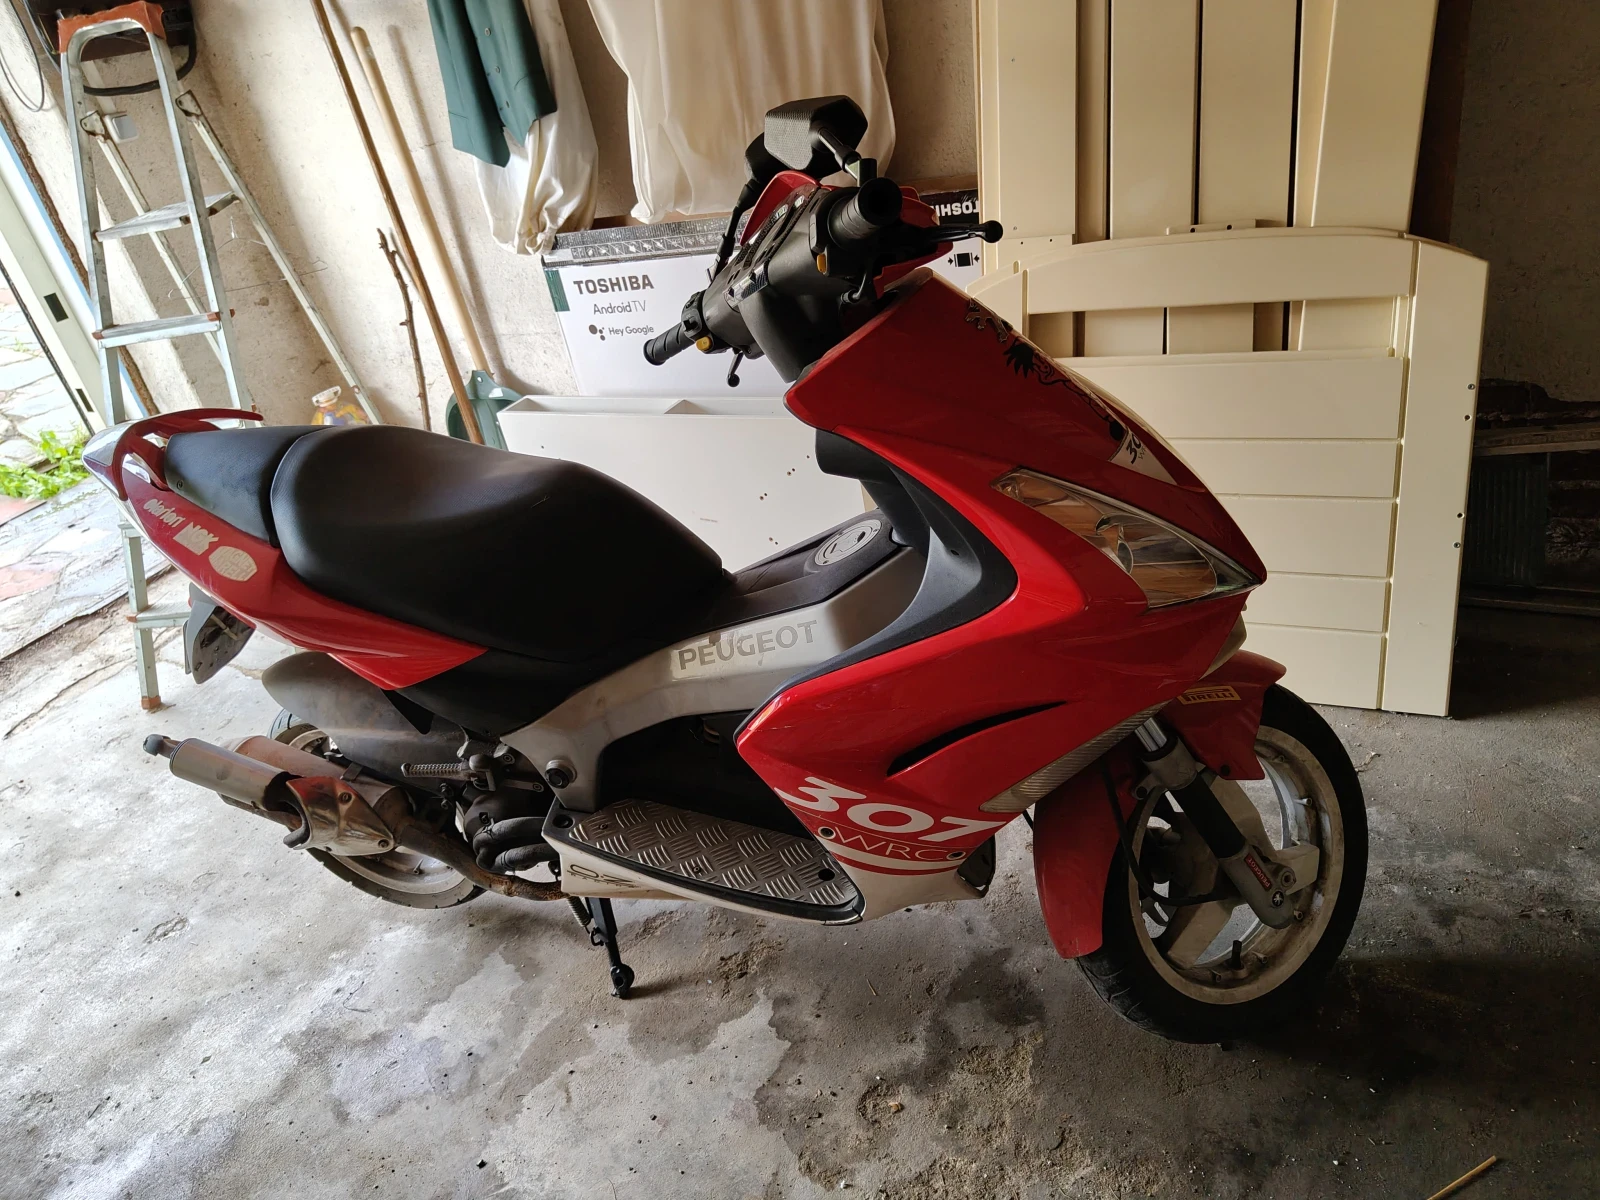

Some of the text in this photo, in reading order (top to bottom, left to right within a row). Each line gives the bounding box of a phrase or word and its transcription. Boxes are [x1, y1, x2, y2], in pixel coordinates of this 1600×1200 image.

[930, 200, 980, 217] TOSHI
[573, 274, 655, 295] TOSHIBA
[608, 325, 655, 337] Hey Google
[678, 619, 818, 671] PEUGEOT
[1182, 688, 1235, 702] PIRELLI
[774, 776, 1007, 842] 307
[834, 826, 951, 861] WRC
[1247, 858, 1271, 888] PEUGEOT
